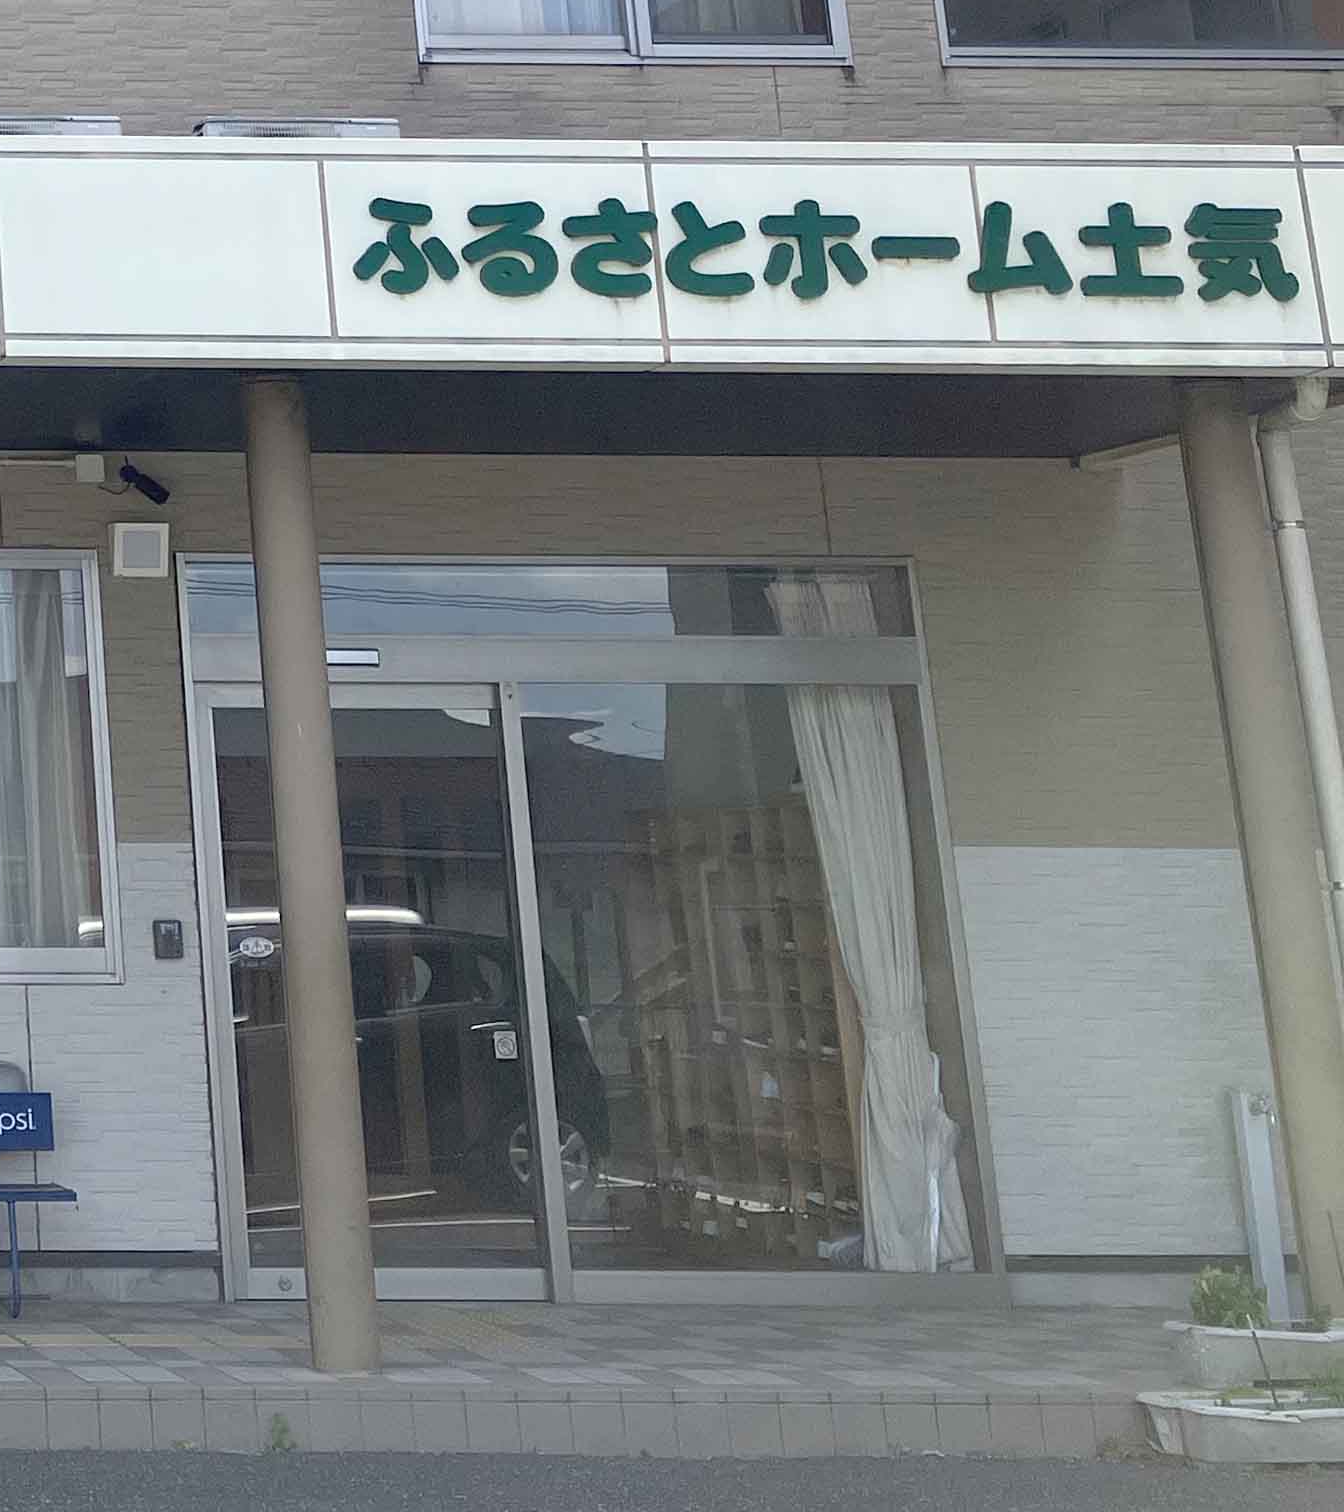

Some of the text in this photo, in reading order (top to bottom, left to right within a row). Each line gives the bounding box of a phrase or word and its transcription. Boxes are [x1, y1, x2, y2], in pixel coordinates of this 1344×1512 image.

[353, 197, 1300, 301] ふるさとホーム土気
